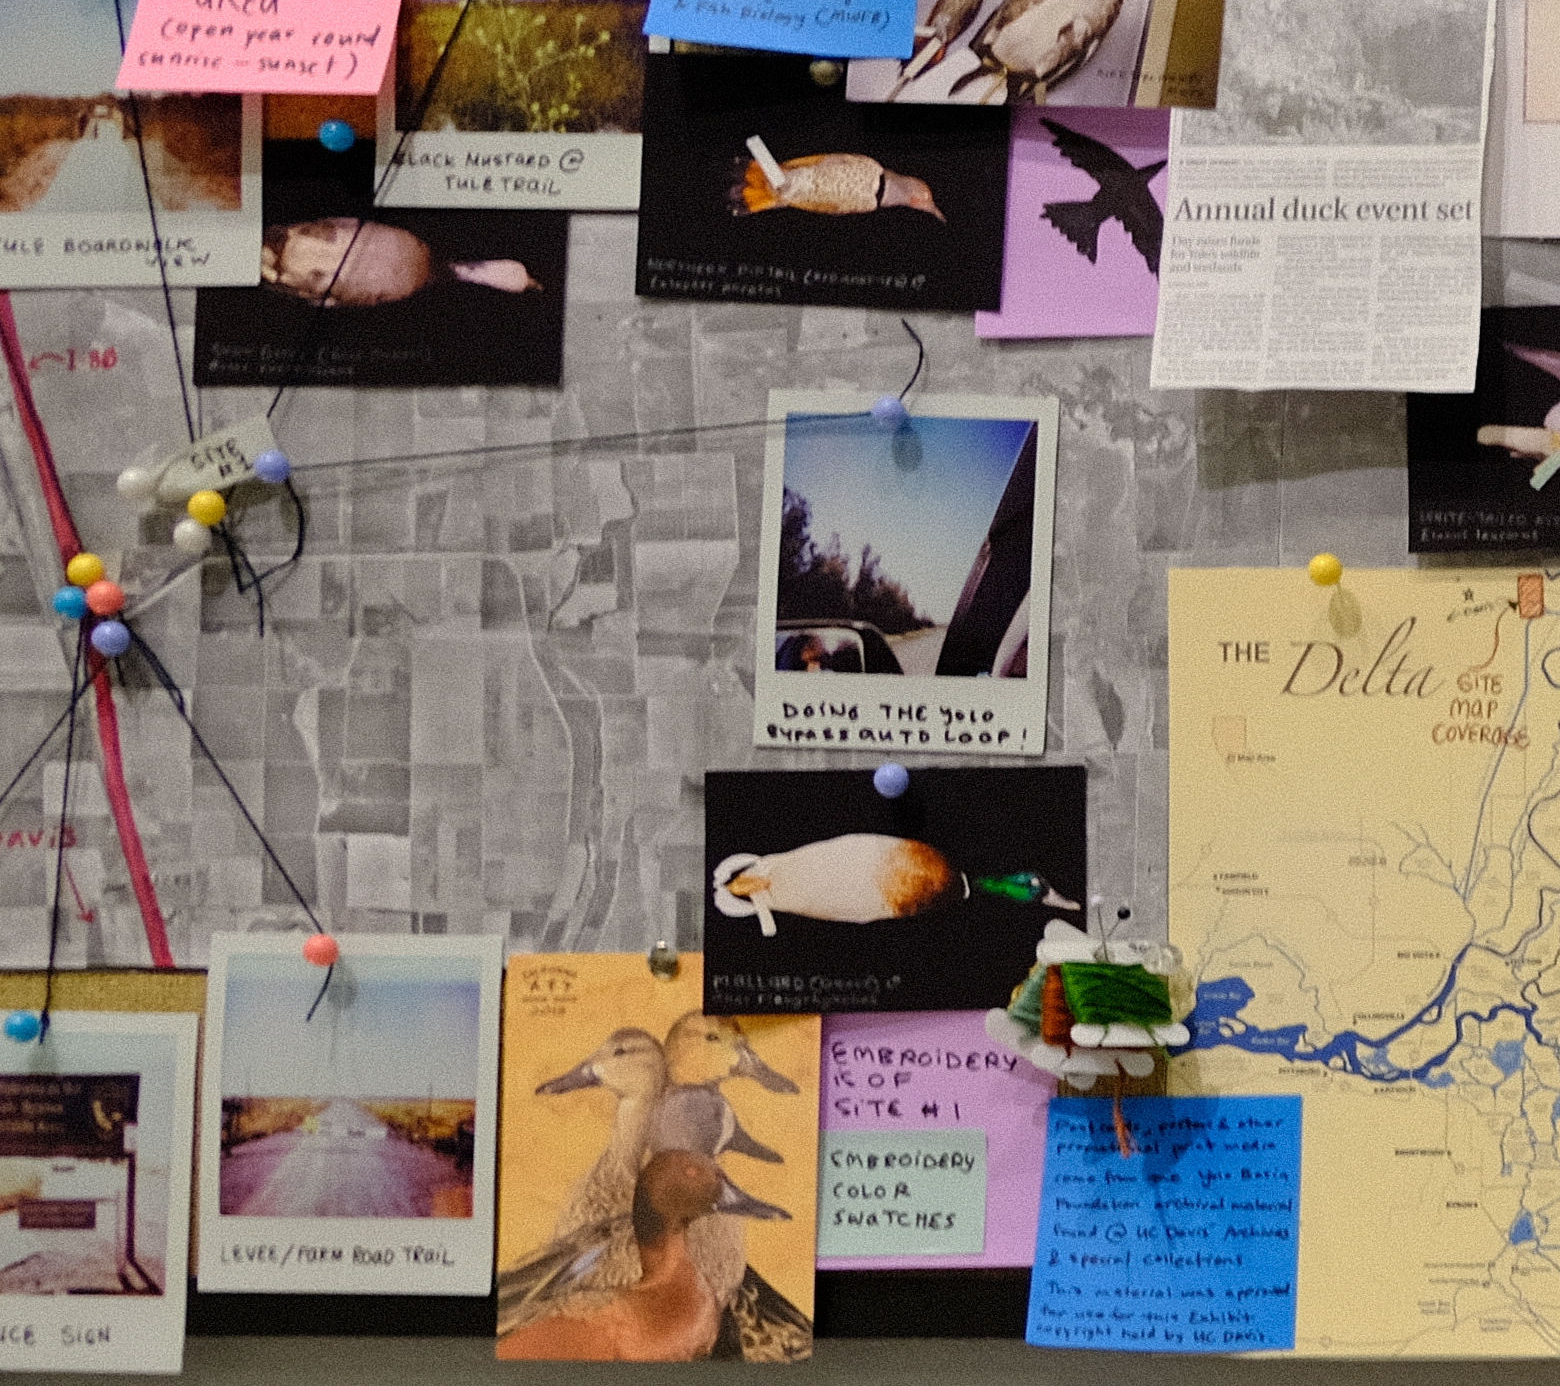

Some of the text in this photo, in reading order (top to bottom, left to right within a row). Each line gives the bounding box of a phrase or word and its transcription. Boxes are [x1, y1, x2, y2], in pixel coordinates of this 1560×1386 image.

[1174, 197, 1473, 222] Annual duck event set
[1219, 617, 1447, 699] THE Delta
[868, 1070, 912, 1088] OF
